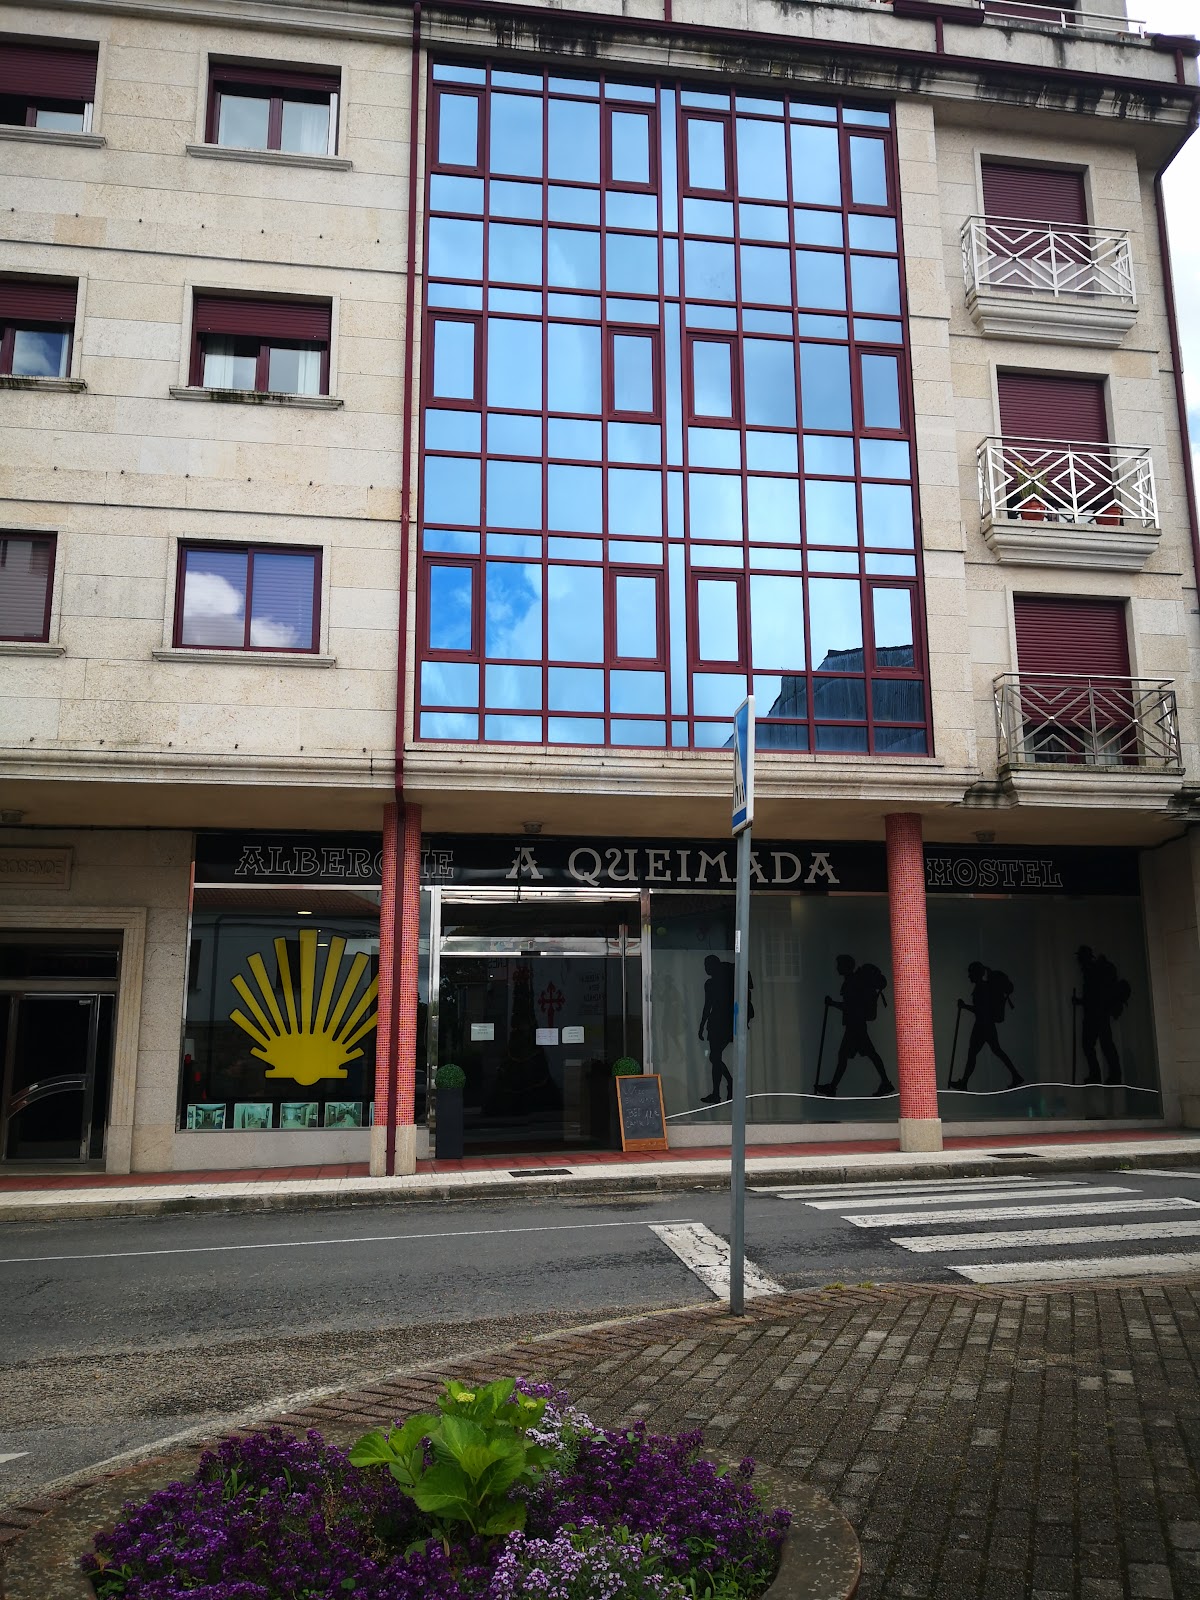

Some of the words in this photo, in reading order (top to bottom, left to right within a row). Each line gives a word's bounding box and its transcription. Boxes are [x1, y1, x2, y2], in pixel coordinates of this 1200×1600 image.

[234, 845, 454, 879] ALBERE
[505, 846, 544, 880] A
[568, 847, 840, 887] QUEIMADA
[926, 858, 1063, 887] HOSTEL
